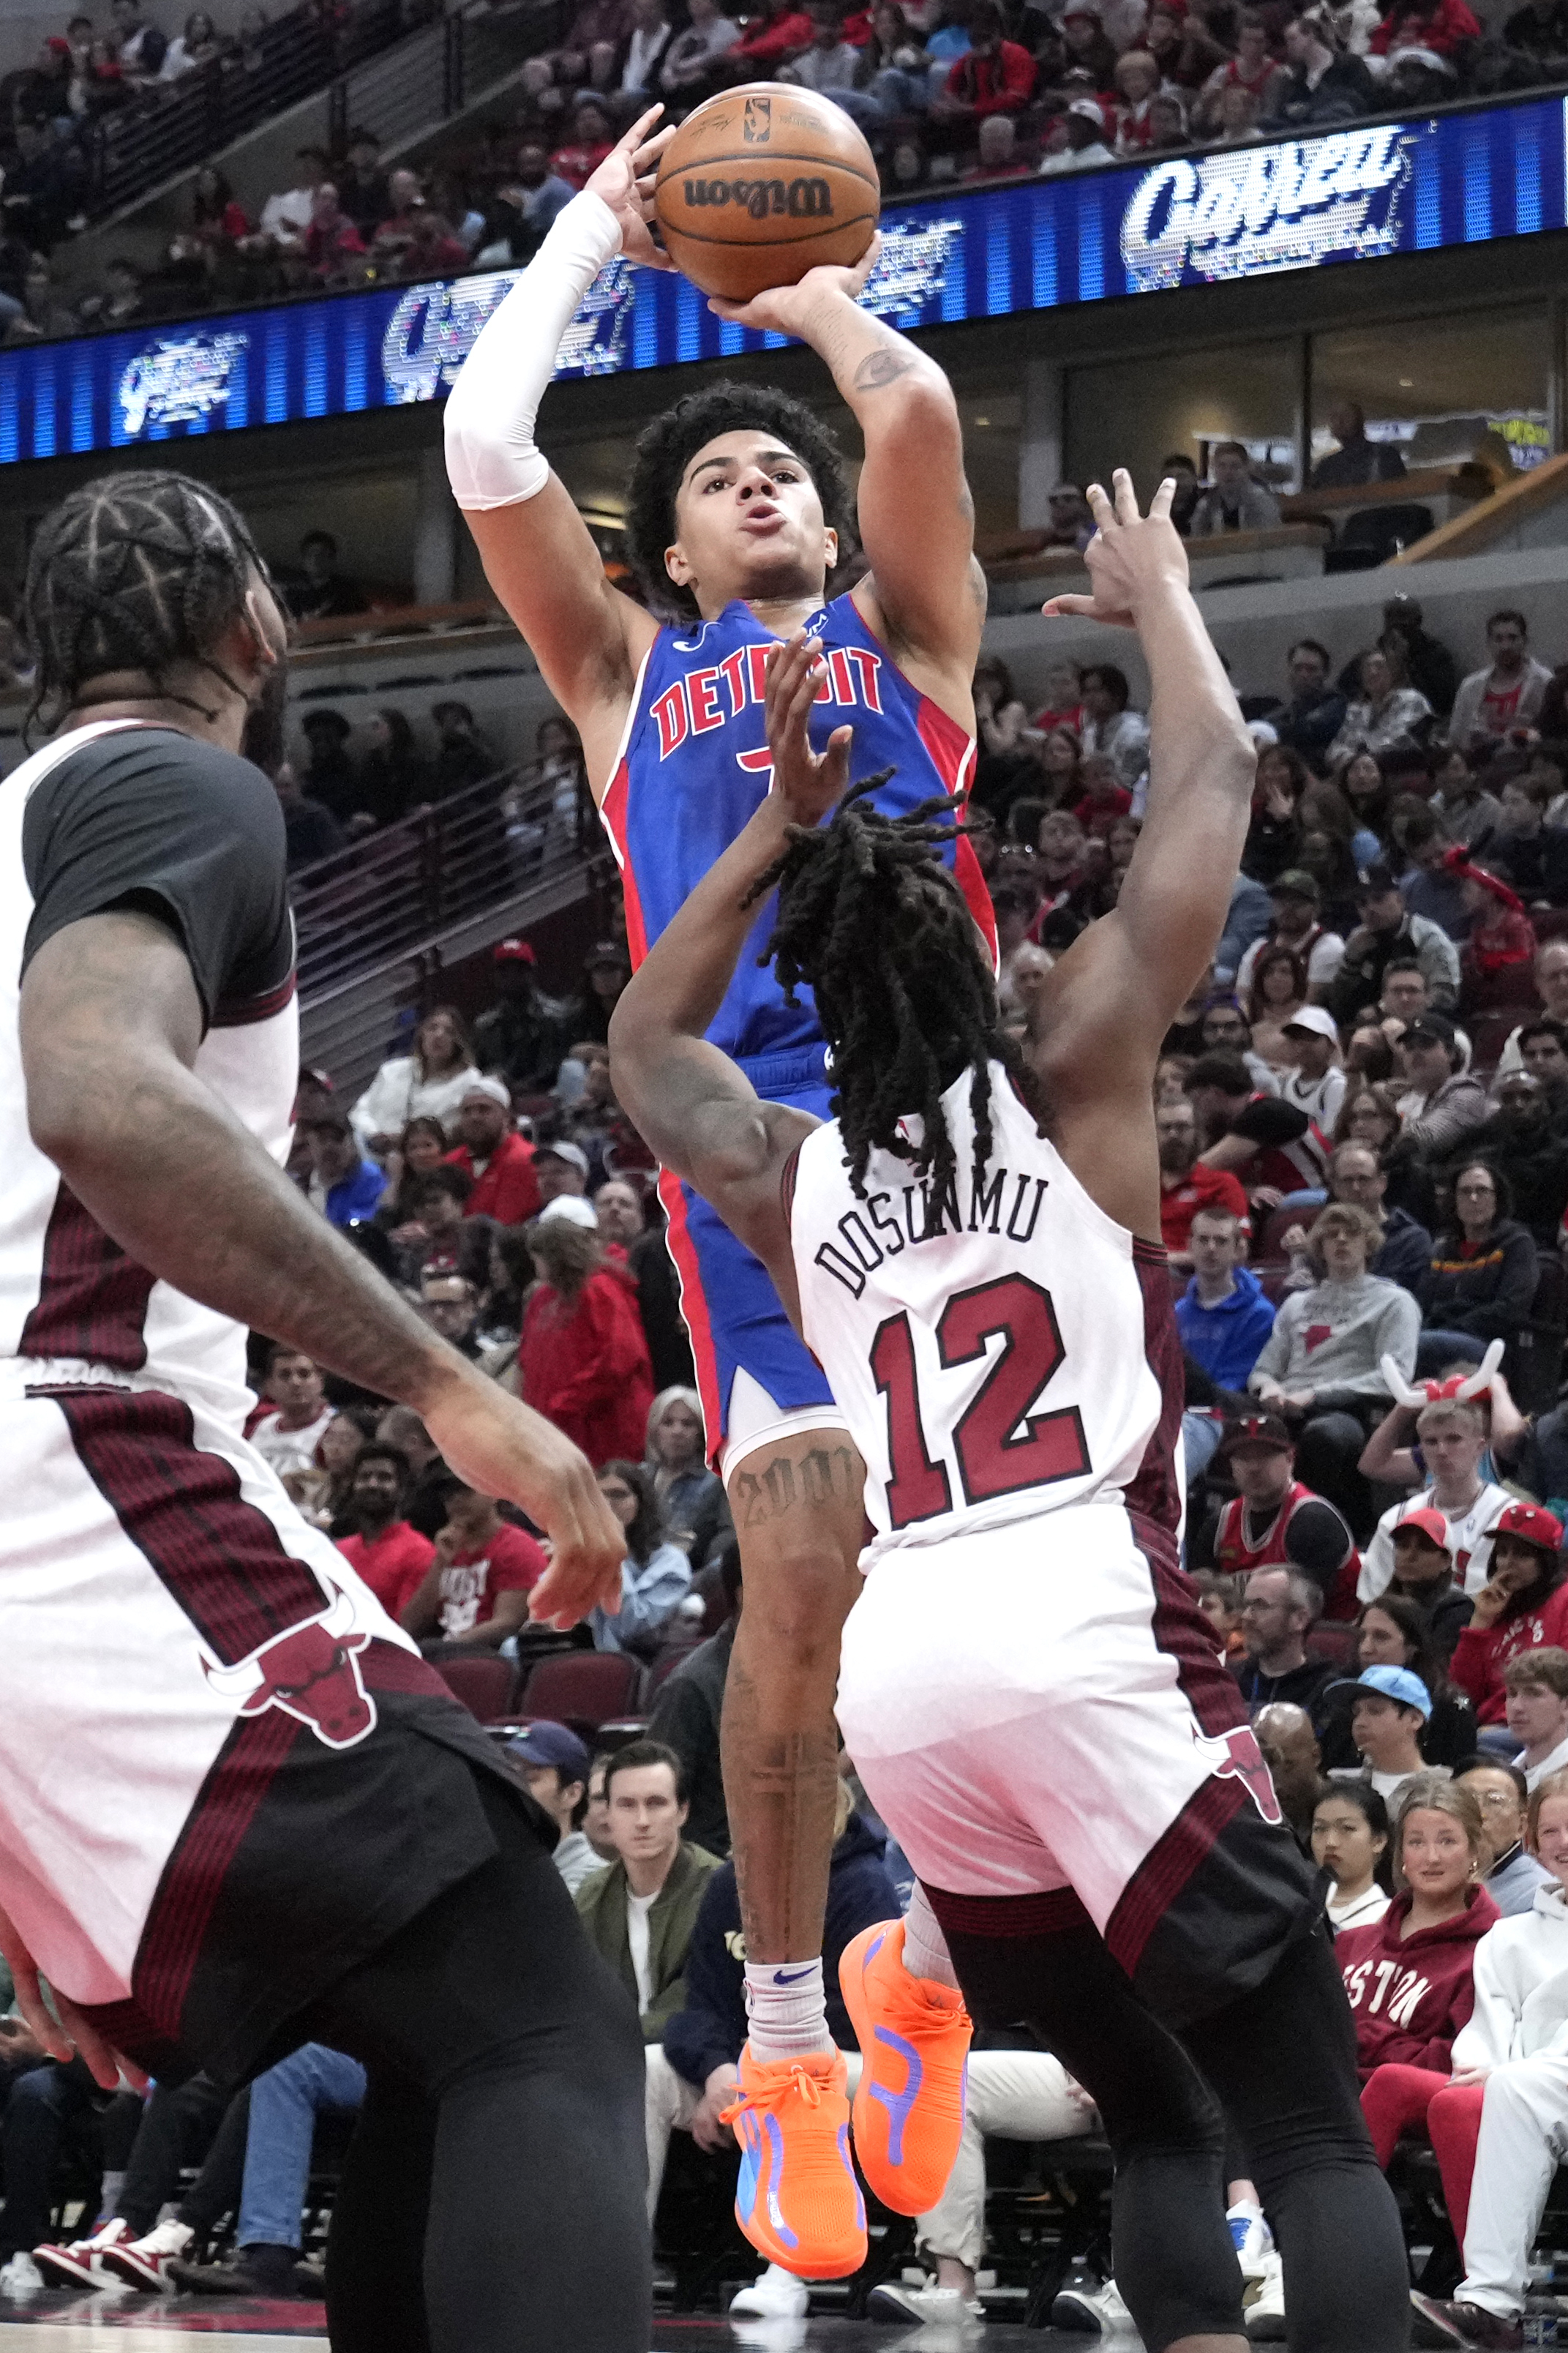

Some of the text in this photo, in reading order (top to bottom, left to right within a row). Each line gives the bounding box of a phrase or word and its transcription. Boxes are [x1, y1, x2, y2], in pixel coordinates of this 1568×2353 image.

[683, 177, 834, 220] Wilson
[814, 1166, 1049, 1301] DOSUNMU
[869, 1271, 1093, 1532] 12
